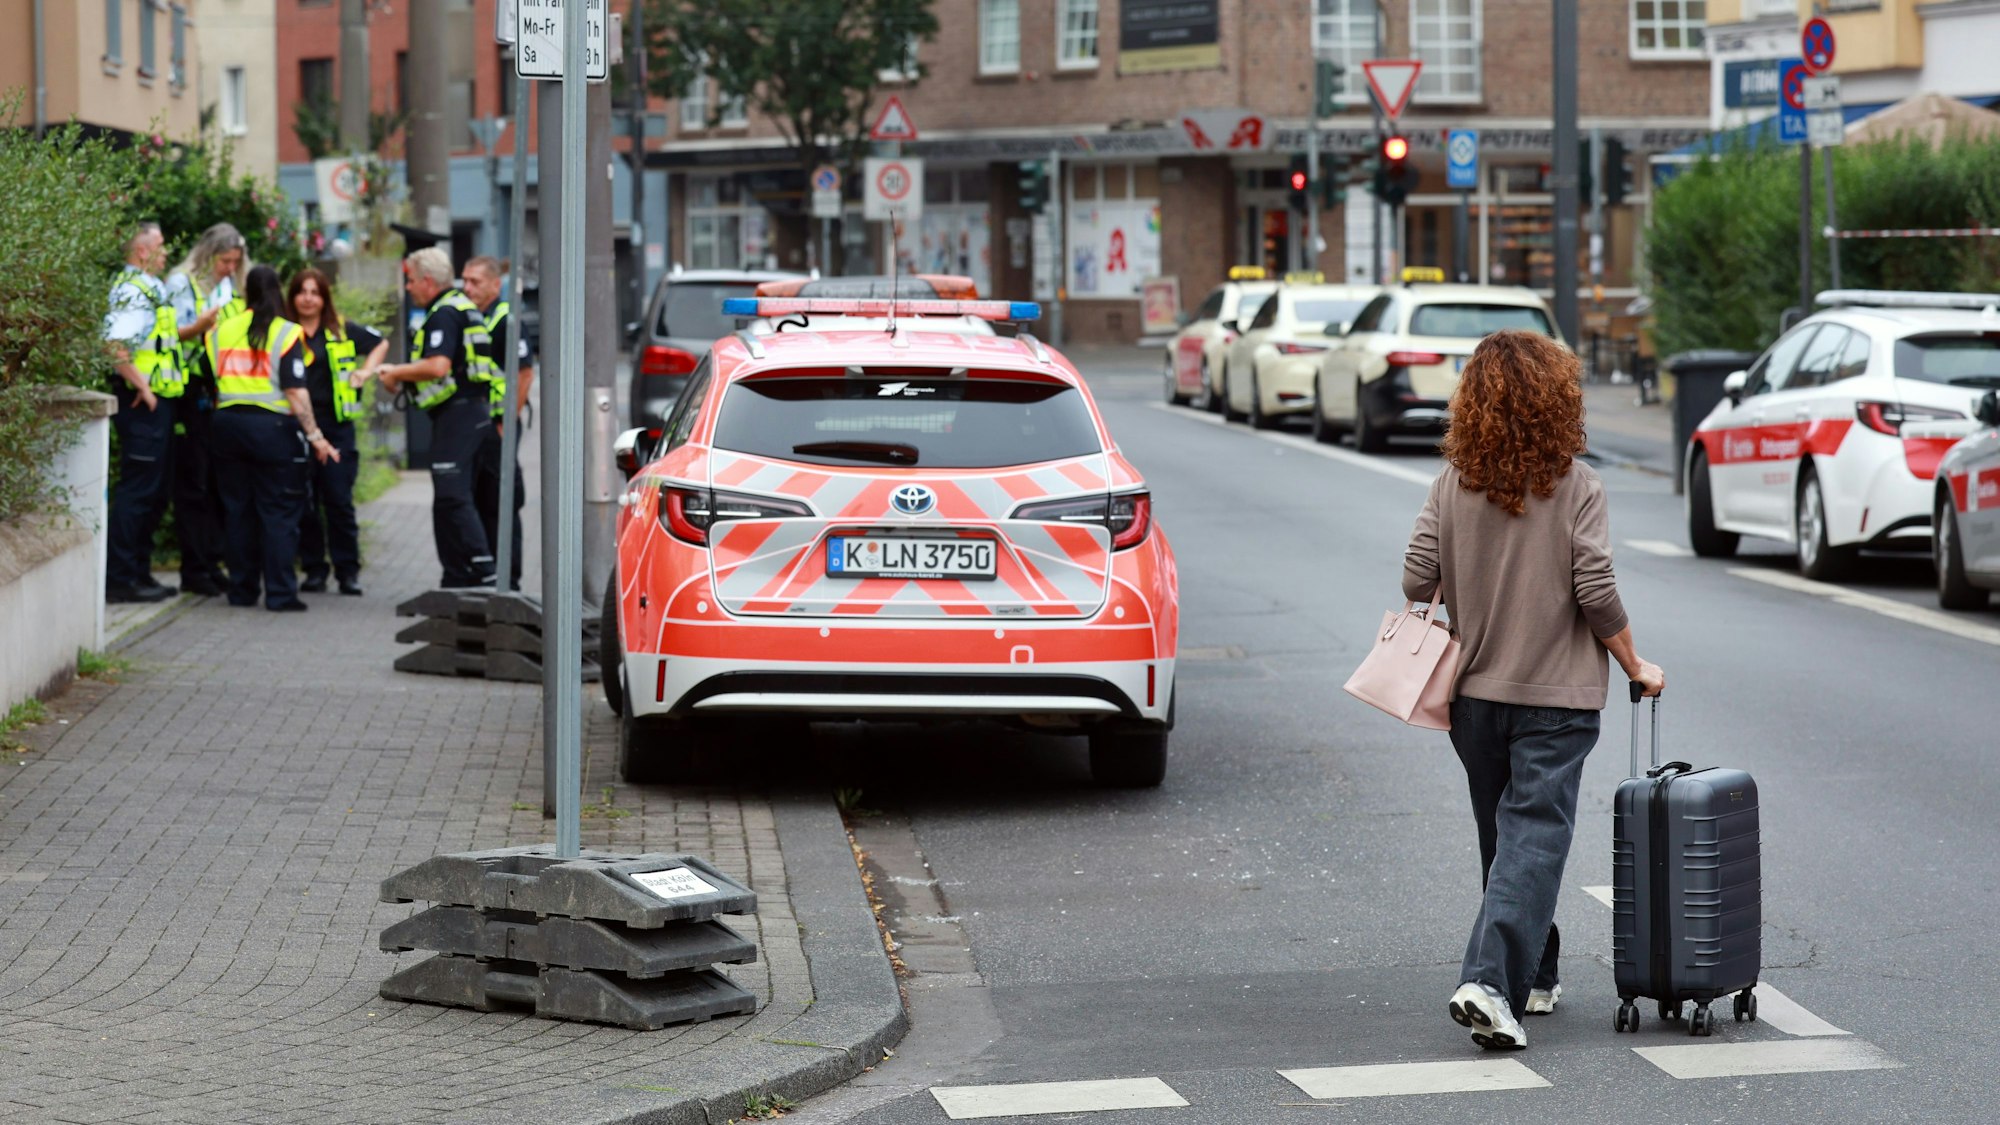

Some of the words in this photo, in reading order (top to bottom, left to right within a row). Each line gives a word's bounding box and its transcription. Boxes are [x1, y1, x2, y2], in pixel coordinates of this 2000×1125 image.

[524, 18, 556, 35] Mo-Fr
[593, 21, 600, 38] h
[524, 45, 537, 63] Sa
[593, 48, 600, 65] h
[847, 543, 862, 568] K
[883, 543, 917, 569] LN
[923, 544, 990, 570] 3750
[667, 873, 697, 885] Köln
